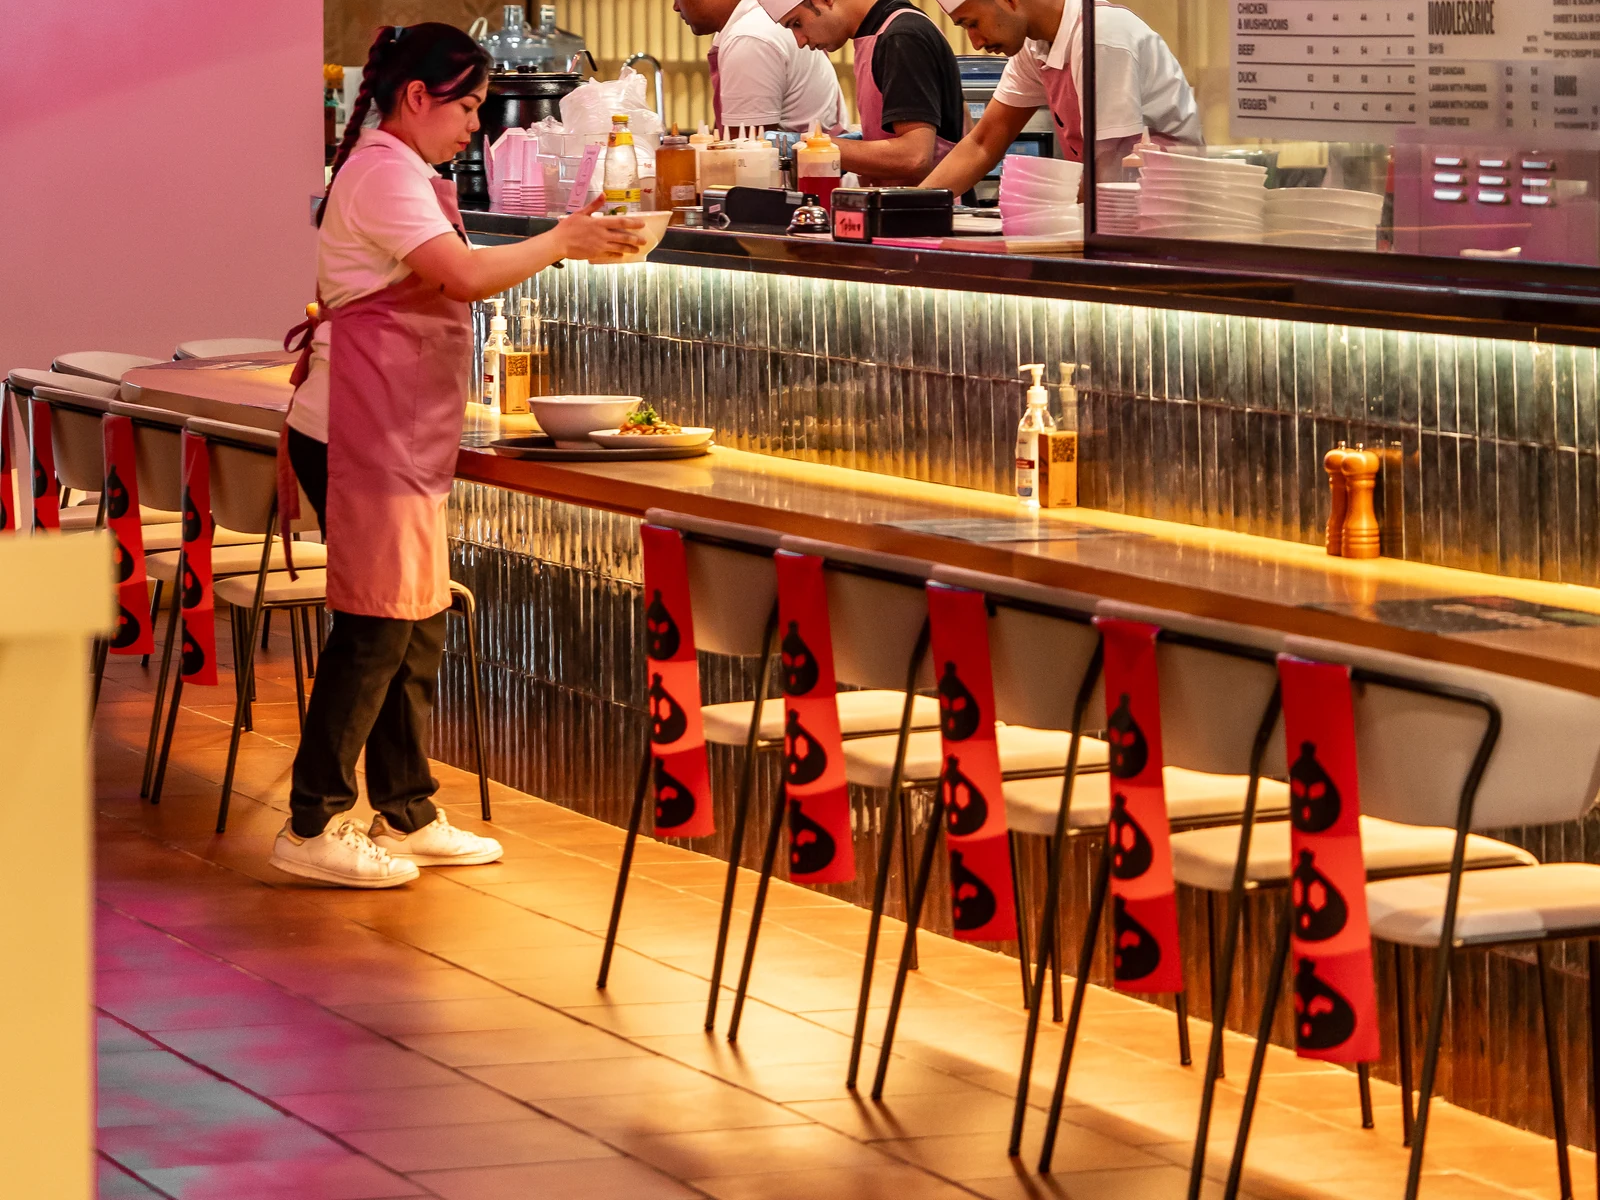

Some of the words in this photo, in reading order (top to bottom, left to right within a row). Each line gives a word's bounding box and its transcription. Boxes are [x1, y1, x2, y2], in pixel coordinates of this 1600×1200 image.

[1237, 2, 1268, 15] CHICKEN
[1428, 0, 1495, 35] NOODLES&RICE
[1243, 18, 1289, 31] MUSHROOMS
[1237, 44, 1255, 56] BEEF
[1238, 71, 1257, 83] DUCK
[1238, 98, 1267, 111] VEGGIES
